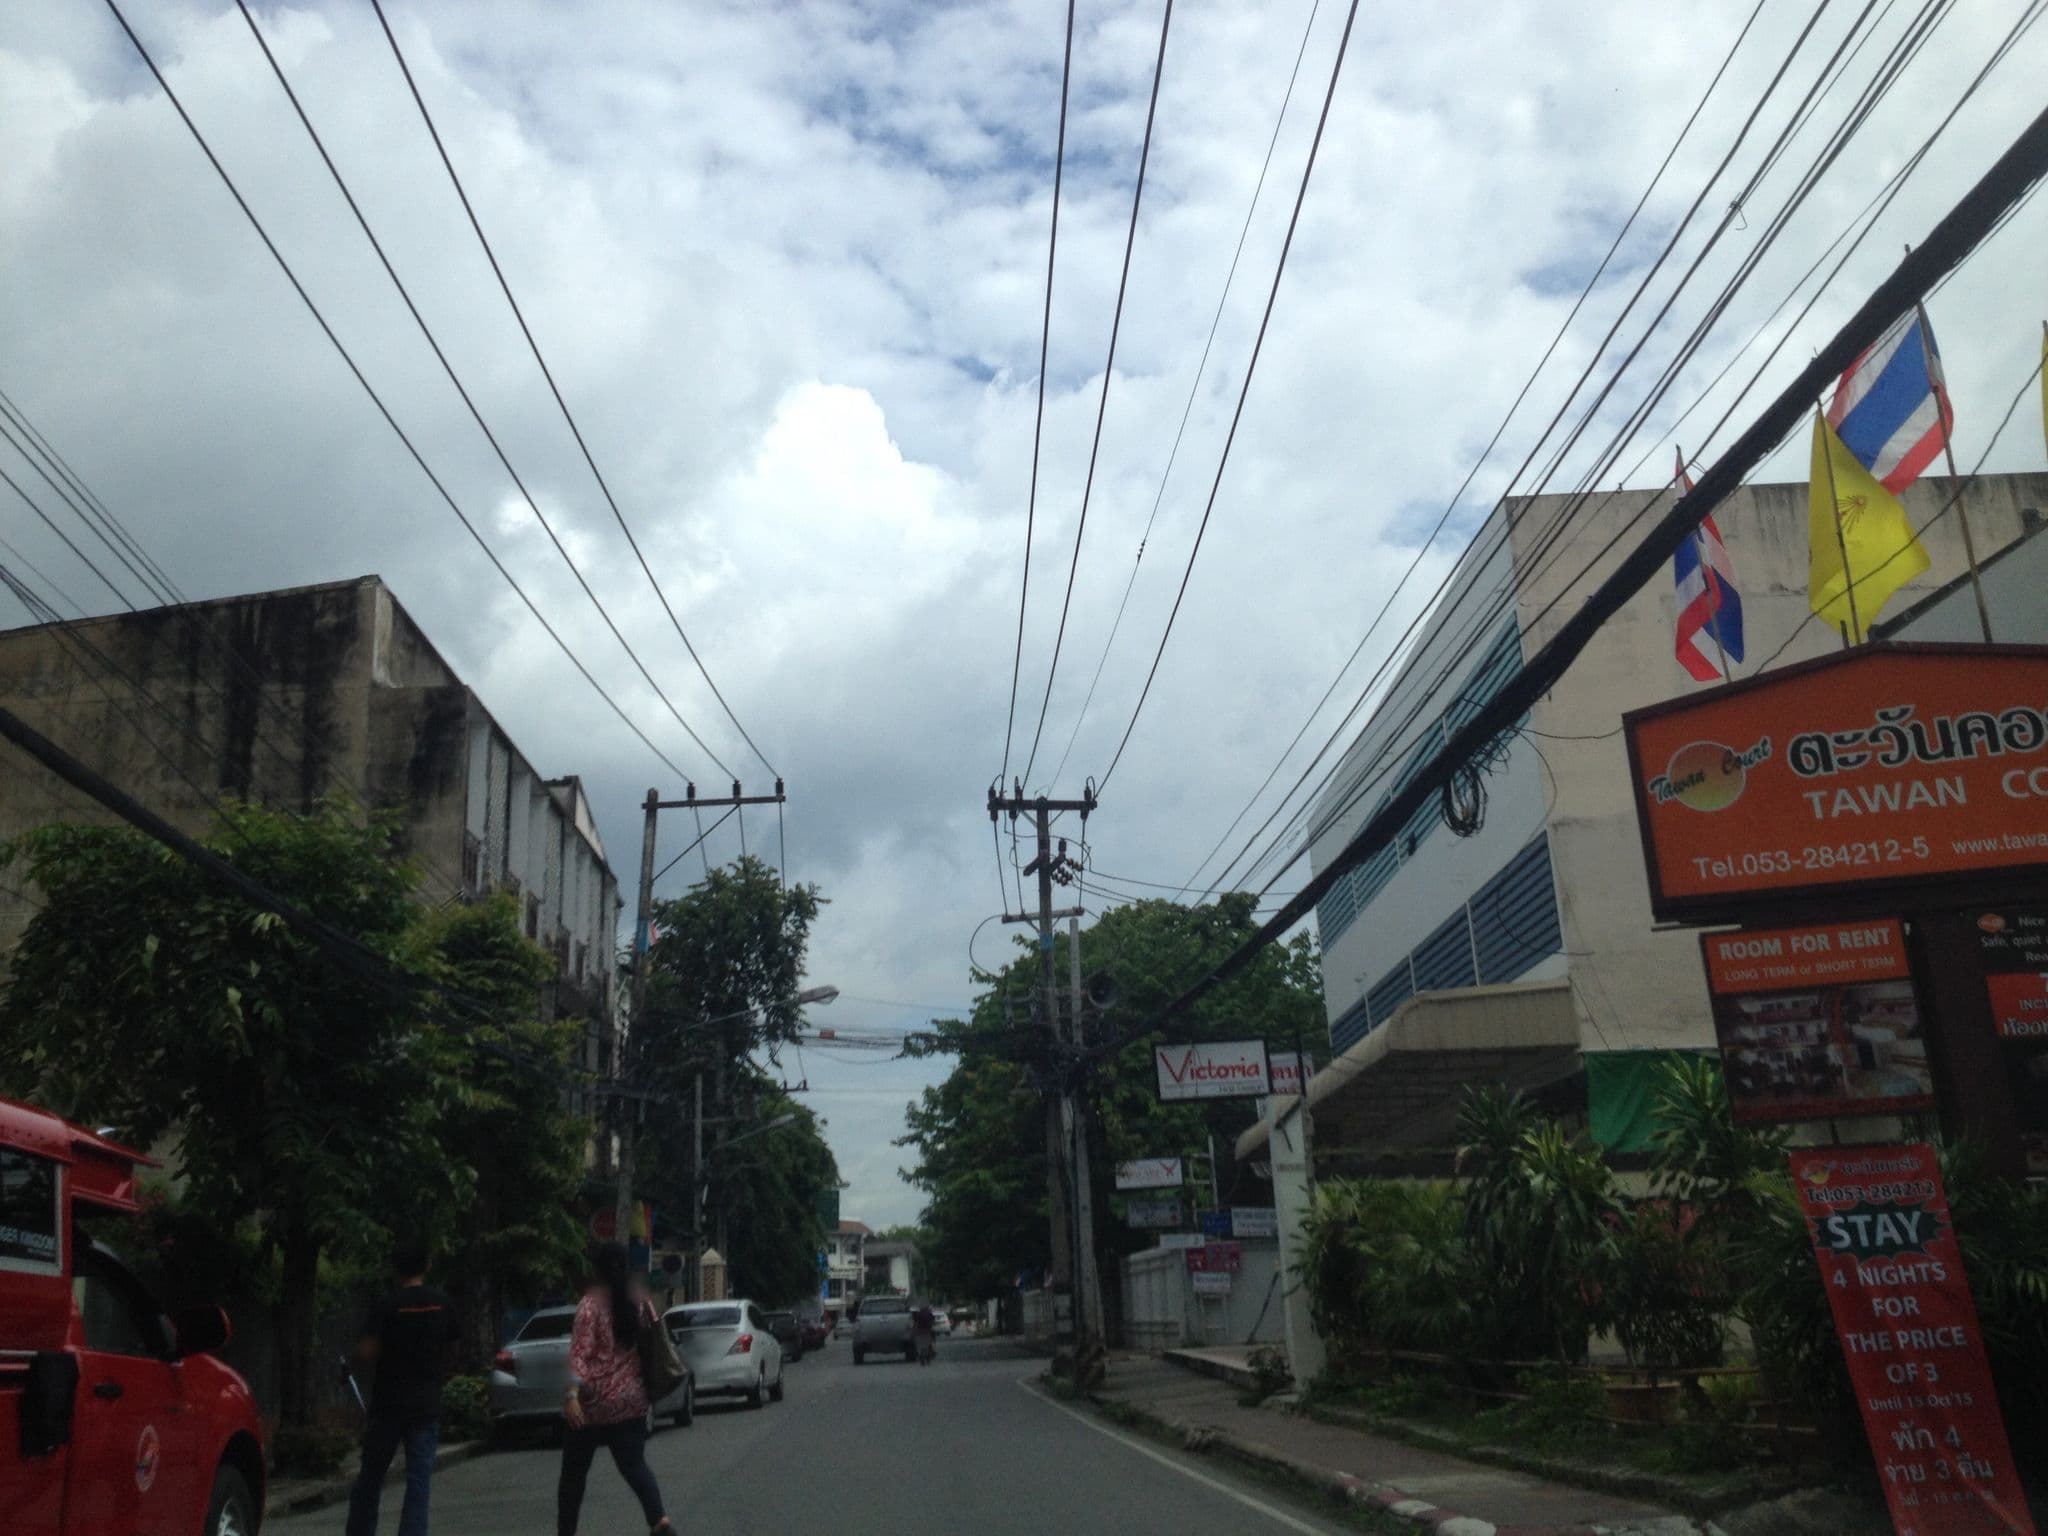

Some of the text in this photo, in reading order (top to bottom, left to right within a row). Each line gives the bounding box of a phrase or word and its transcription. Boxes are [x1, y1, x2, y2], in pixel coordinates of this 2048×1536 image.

[1788, 704, 2048, 777] ตะวันคอ
[1721, 736, 1773, 776] Court
[1803, 777, 1967, 820] TAWAN
[1693, 836, 1931, 880] Tel.053-284212-5
[1718, 927, 1891, 960] ROOM FOR RENT
[1725, 967, 1760, 982] LONG
[1763, 965, 1797, 979] TERM
[1815, 959, 1857, 975] SHORT
[1862, 955, 1897, 969] TERM
[1159, 1048, 1261, 1083] Victoria
[1827, 1211, 1922, 1248] STAY
[1833, 1261, 1949, 1288] 4 NIGHTS
[1872, 1296, 1920, 1317] FOR
[1845, 1325, 1968, 1353] THE PRICE
[1886, 1362, 1940, 1384] OF 3
[1868, 1395, 1903, 1411] Until
[1944, 1424, 1961, 1449] 4
[1936, 1459, 1951, 1481] 3
